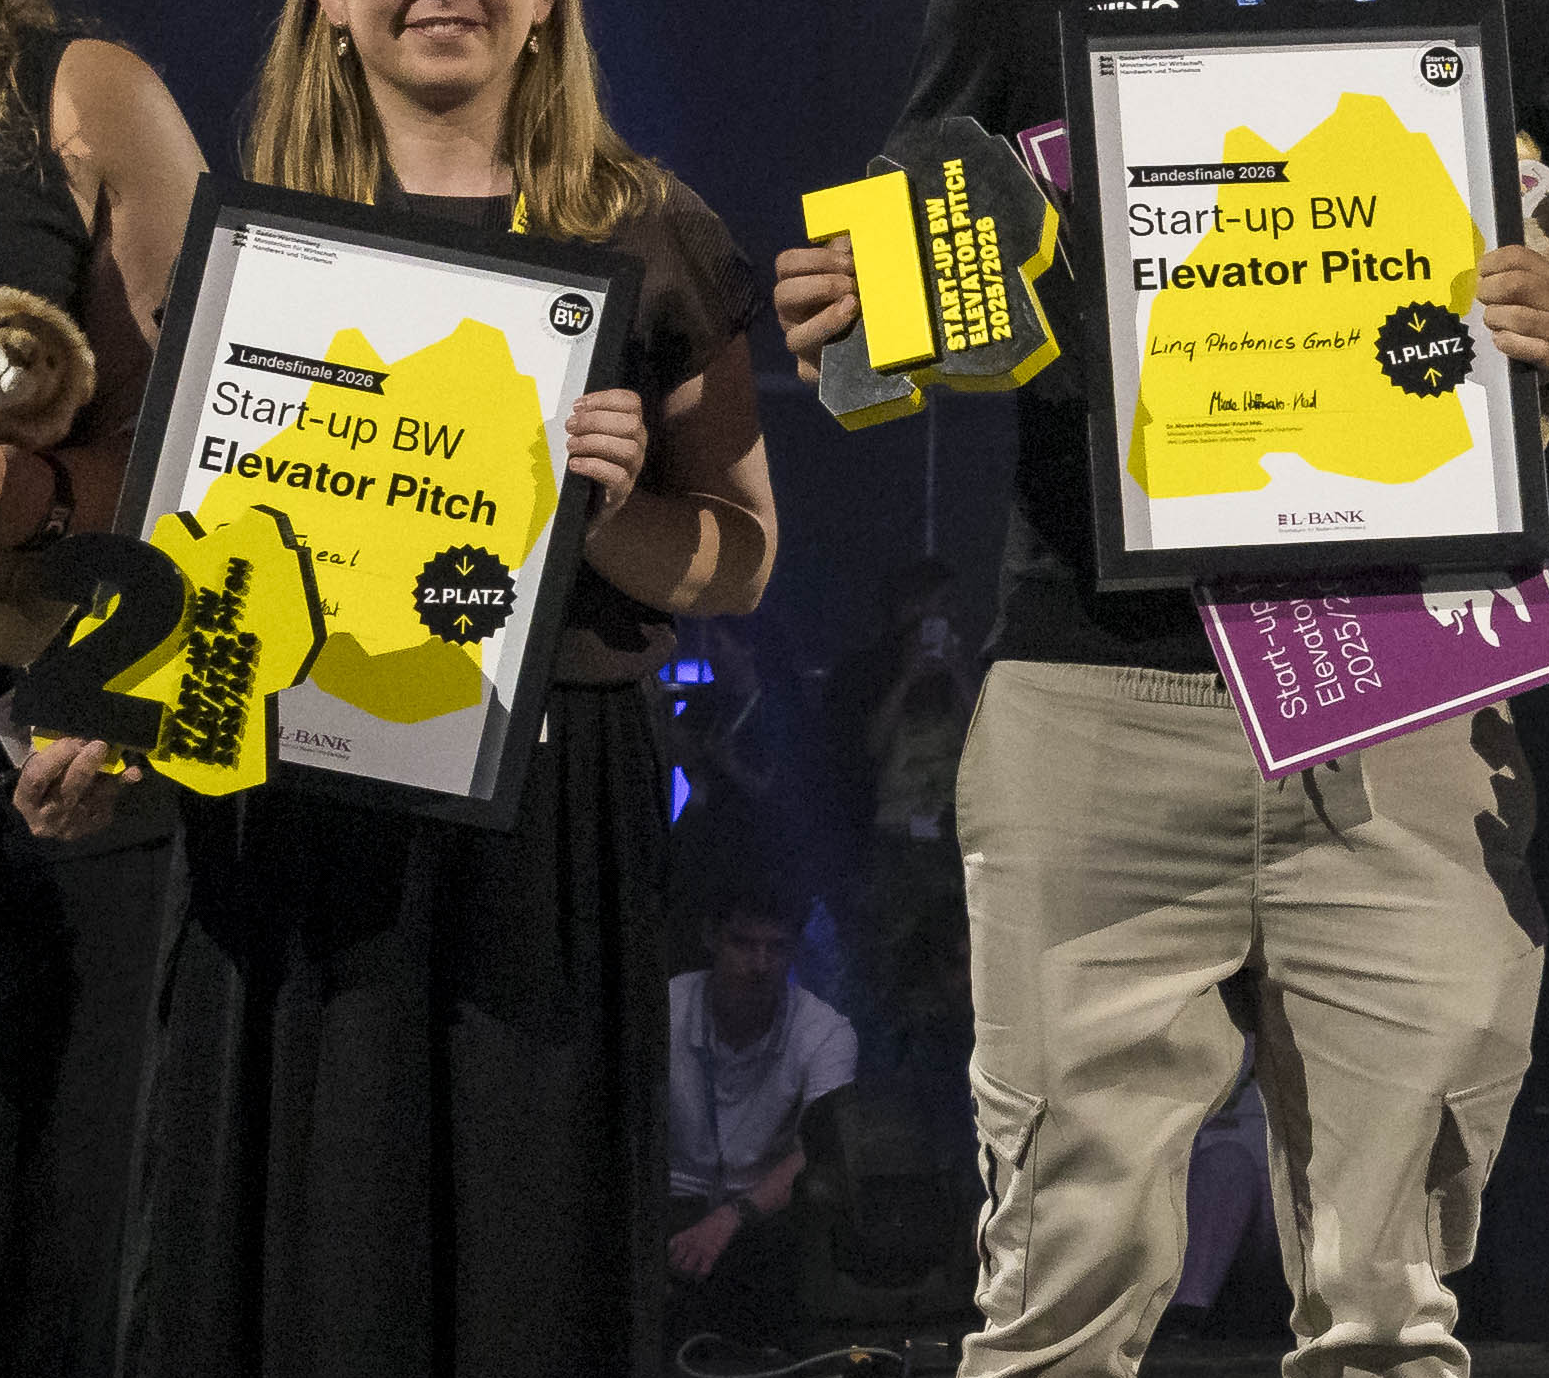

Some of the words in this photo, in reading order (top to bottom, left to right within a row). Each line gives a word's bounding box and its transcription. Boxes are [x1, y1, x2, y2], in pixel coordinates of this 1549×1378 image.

[1425, 55, 1459, 63] Start-up
[1425, 63, 1459, 80] BW
[943, 158, 971, 229] PITCH
[1141, 167, 1235, 183] Landesfinale
[1238, 166, 1276, 180] 2026
[925, 198, 949, 235] BW
[1128, 202, 1295, 240] Start-up
[1310, 195, 1378, 230] BW
[802, 171, 936, 369] 1
[953, 228, 989, 347] ELEVATOR
[976, 216, 1013, 341] 2025/2026
[1132, 256, 1308, 292] Elevator
[1321, 247, 1432, 285] Pitch
[556, 299, 591, 313] Start-up
[932, 237, 967, 351] START-UP
[553, 307, 589, 329] BW
[1204, 331, 1297, 353] Photonics
[1302, 327, 1362, 351] GmbH
[239, 349, 334, 380] Landesfinale
[336, 369, 375, 388] 2026
[212, 380, 379, 450] Start-up
[392, 416, 466, 460] BW
[198, 435, 376, 502] Elevator
[386, 472, 498, 526] Pitch
[1291, 509, 1365, 526] L-BANK
[9, 532, 187, 754] 2
[1250, 599, 1308, 719] Start-up
